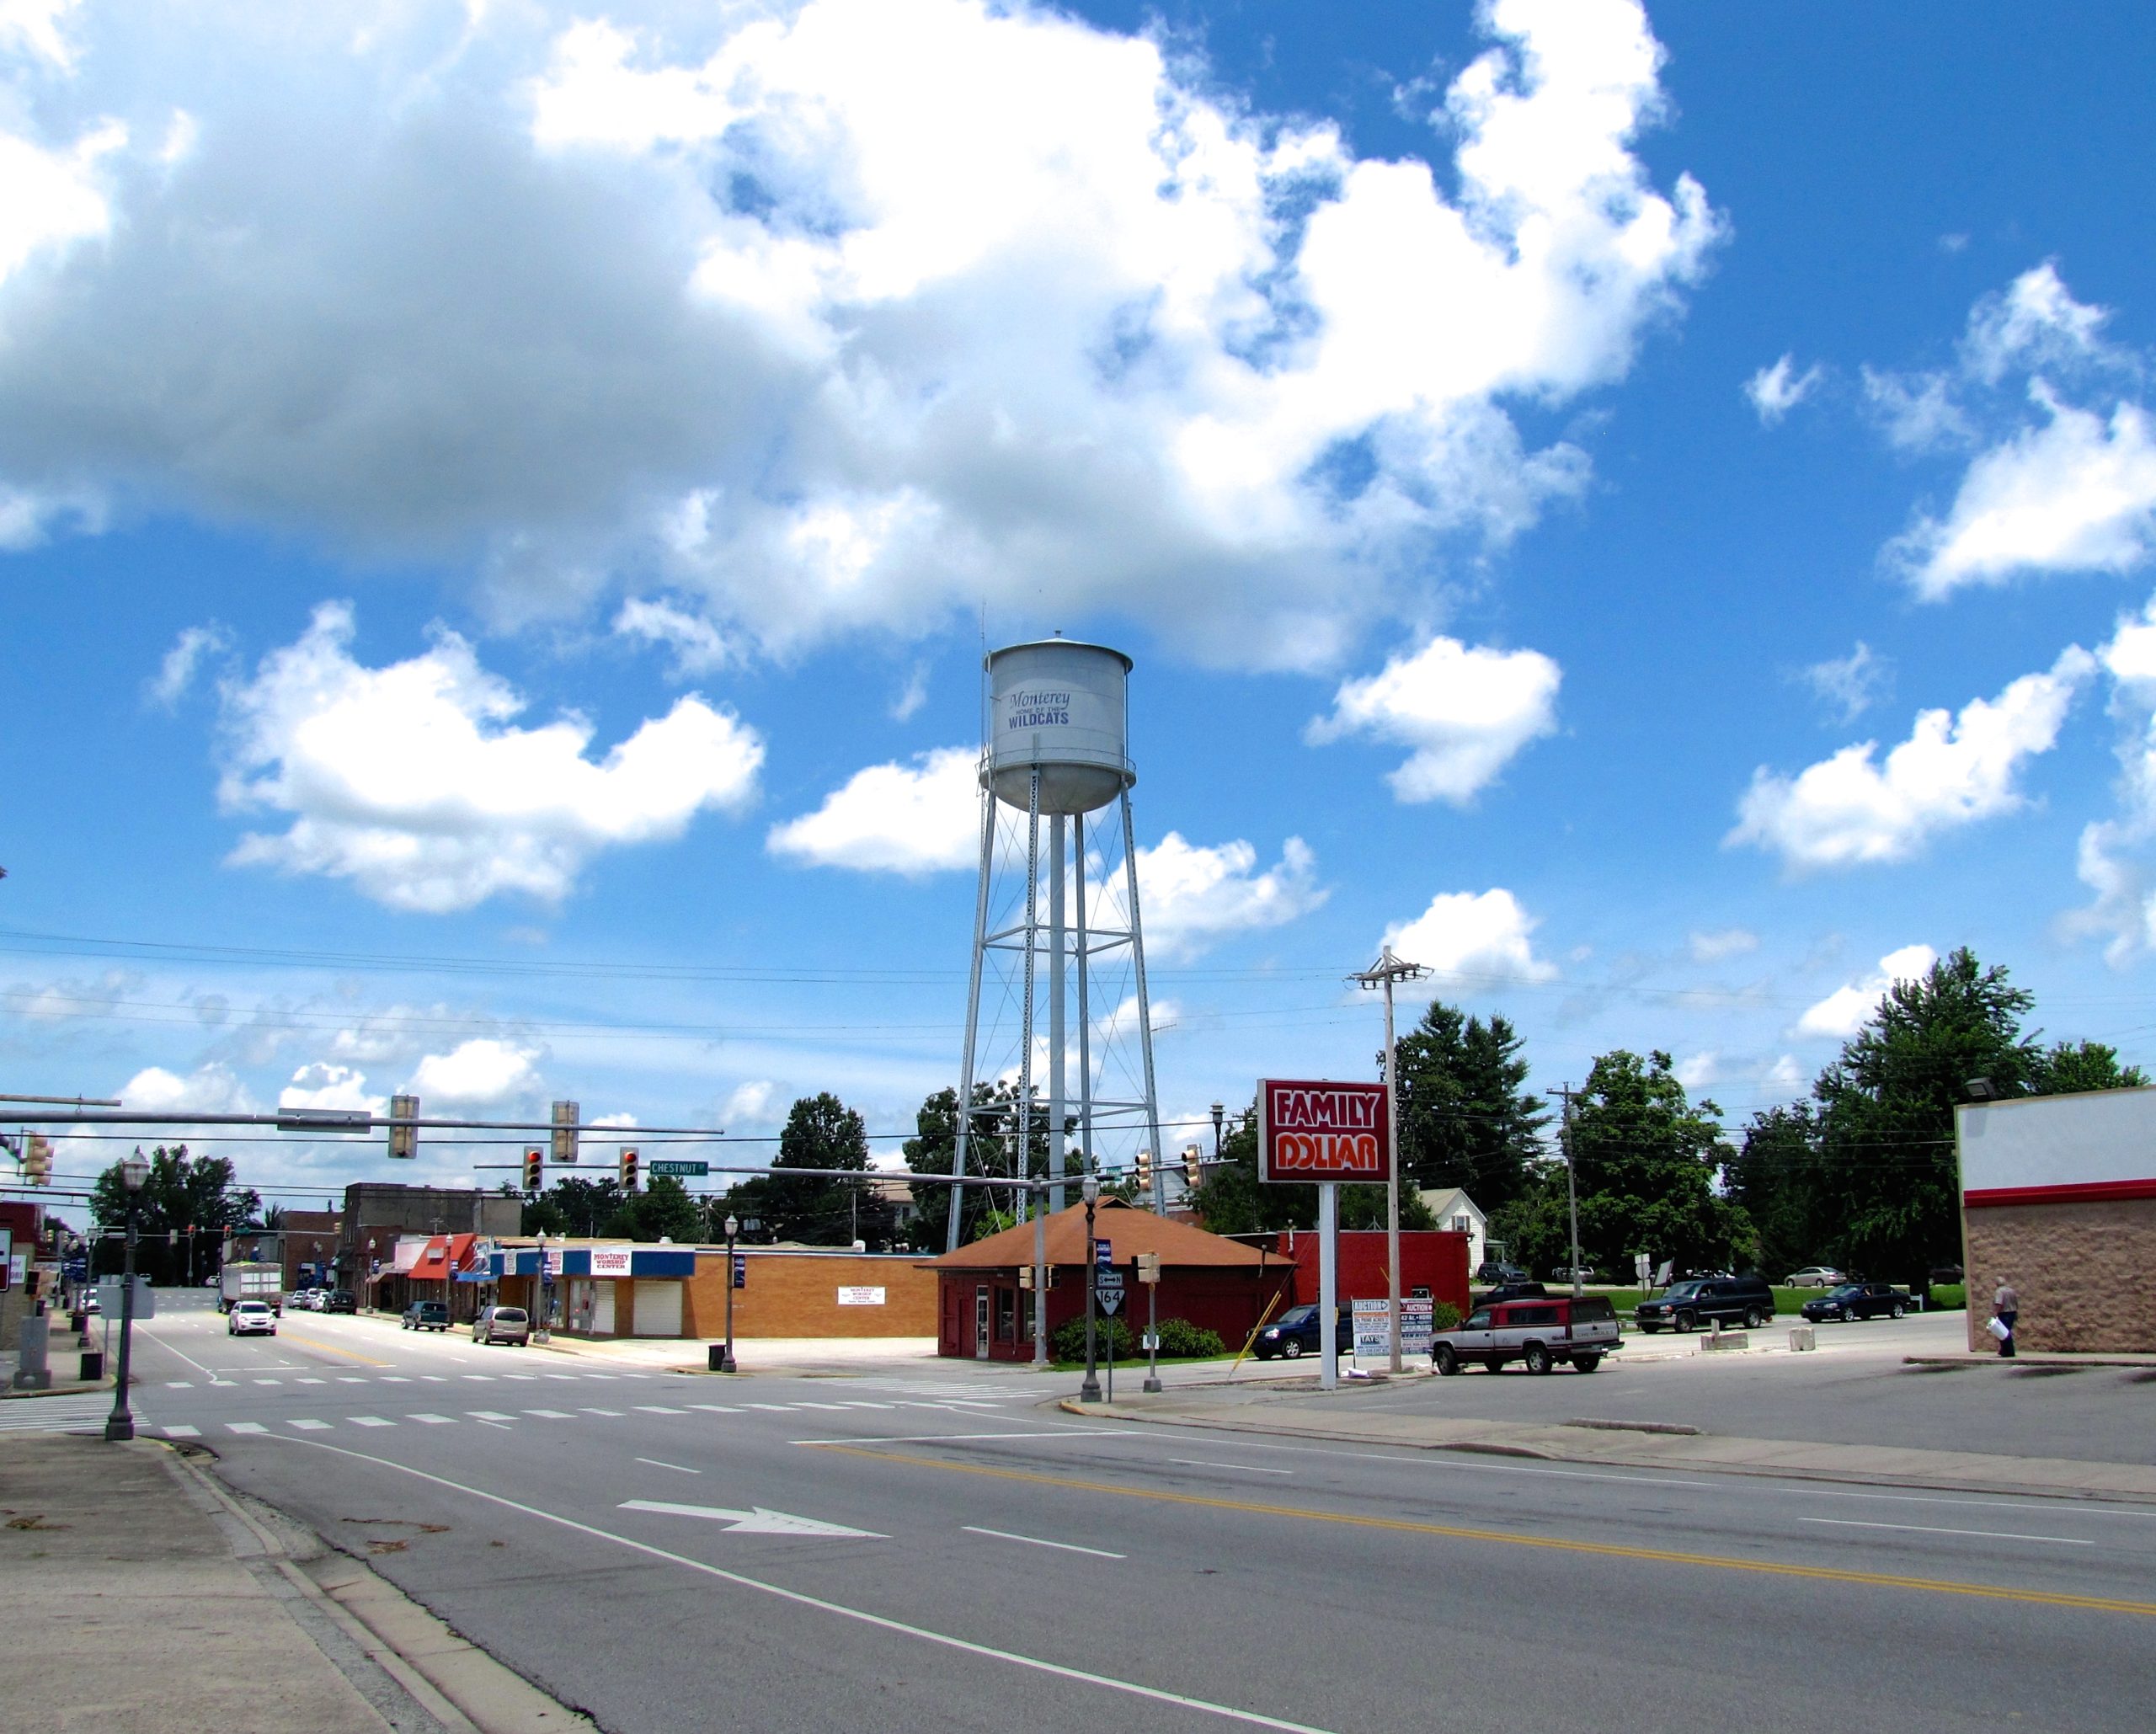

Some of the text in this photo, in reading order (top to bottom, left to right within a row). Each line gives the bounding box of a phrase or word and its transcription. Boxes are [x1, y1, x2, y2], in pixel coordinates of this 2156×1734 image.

[1010, 691, 1070, 710] Monterey
[1009, 712, 1069, 729] WILDCATS
[1274, 1089, 1381, 1128] FAMILY
[1275, 1132, 1379, 1171] DOLLAR
[652, 1163, 696, 1173] CHESTNUT
[1099, 1275, 1104, 1284] S
[1100, 1290, 1120, 1304] 164
[1354, 1301, 1381, 1310] AUCTION
[1361, 1335, 1380, 1343] TAYS
